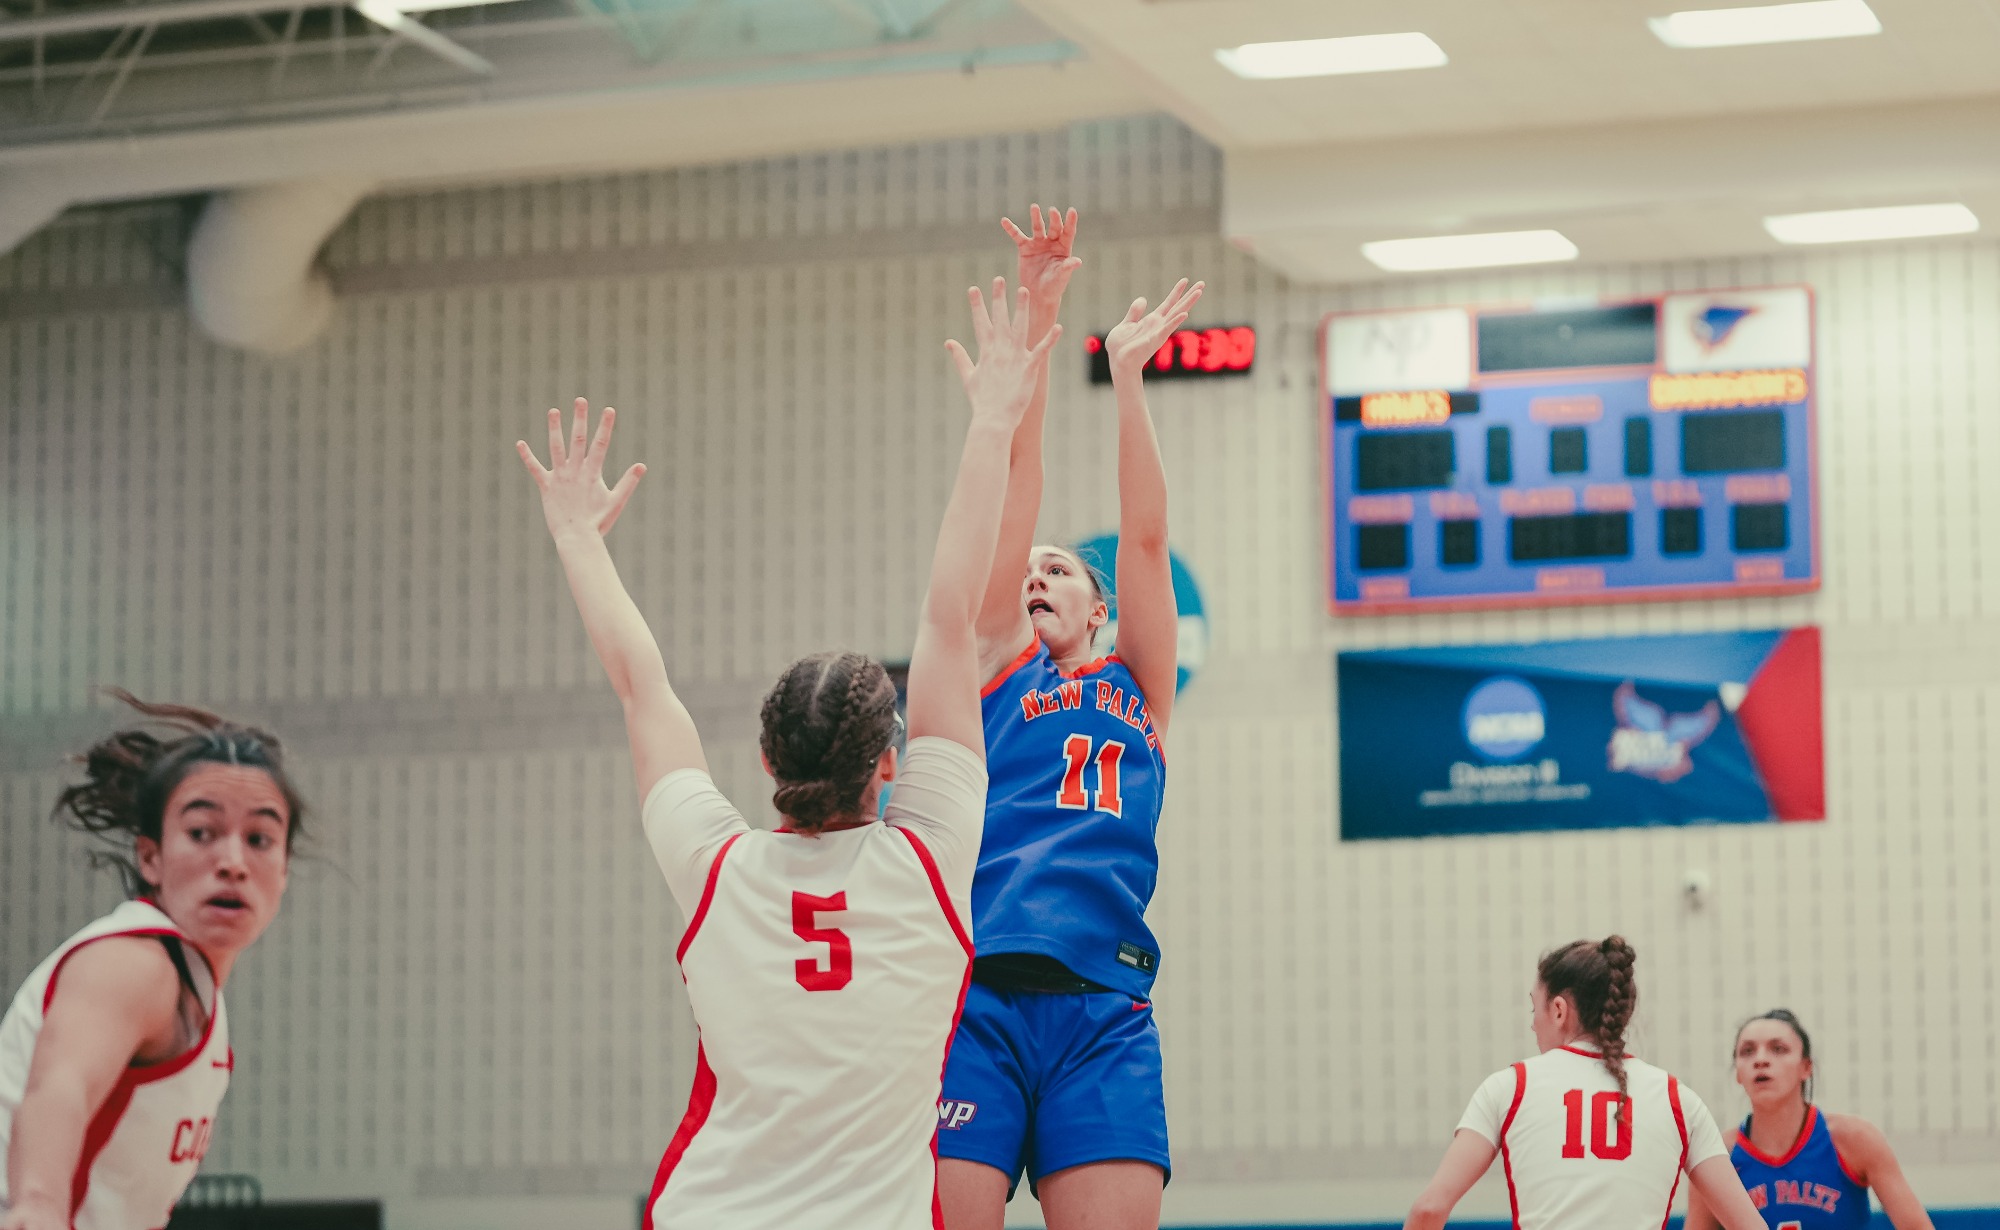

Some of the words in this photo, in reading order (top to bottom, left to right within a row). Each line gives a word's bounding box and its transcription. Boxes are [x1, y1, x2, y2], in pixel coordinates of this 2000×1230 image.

[1020, 679, 1083, 722] NEW
[1056, 732, 1126, 819] 11
[791, 890, 853, 992] 5
[1562, 1088, 1633, 1161] 10
[1774, 1179, 1842, 1214] PALTZ
